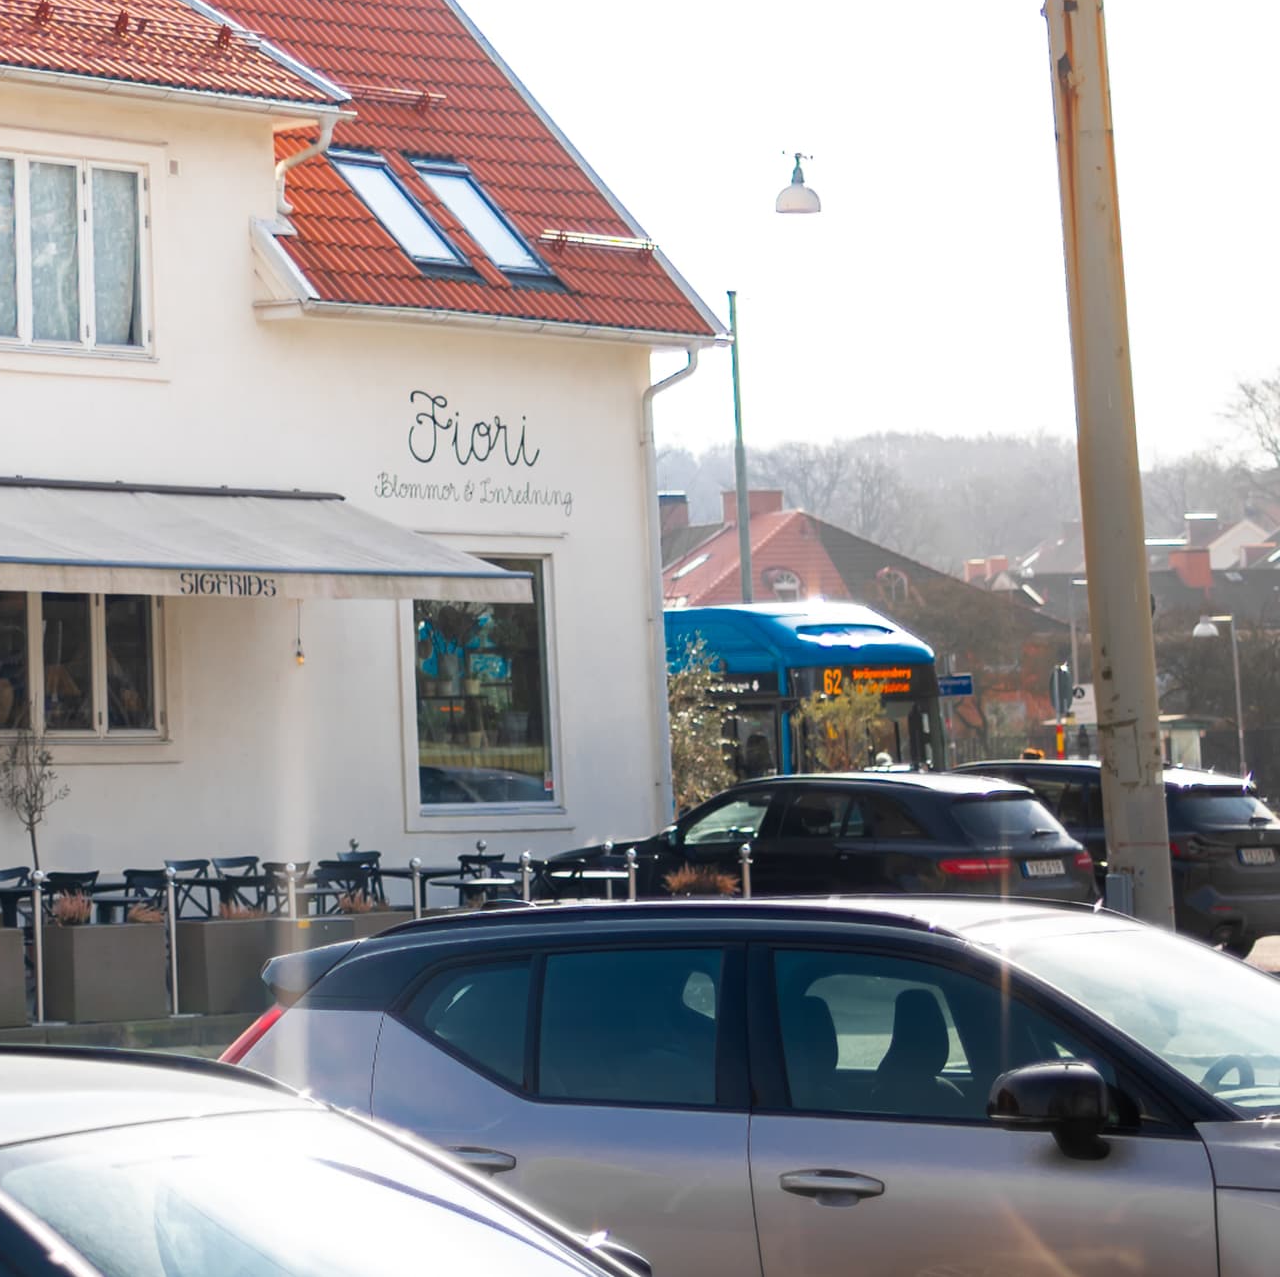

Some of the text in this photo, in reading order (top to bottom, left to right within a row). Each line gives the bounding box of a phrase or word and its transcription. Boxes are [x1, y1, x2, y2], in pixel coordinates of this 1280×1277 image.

[408, 390, 540, 467] Fiori
[374, 472, 460, 502] Blommor
[479, 477, 573, 517] Inredning
[180, 572, 277, 597] SIGFRIDS
[823, 668, 843, 695] 62
